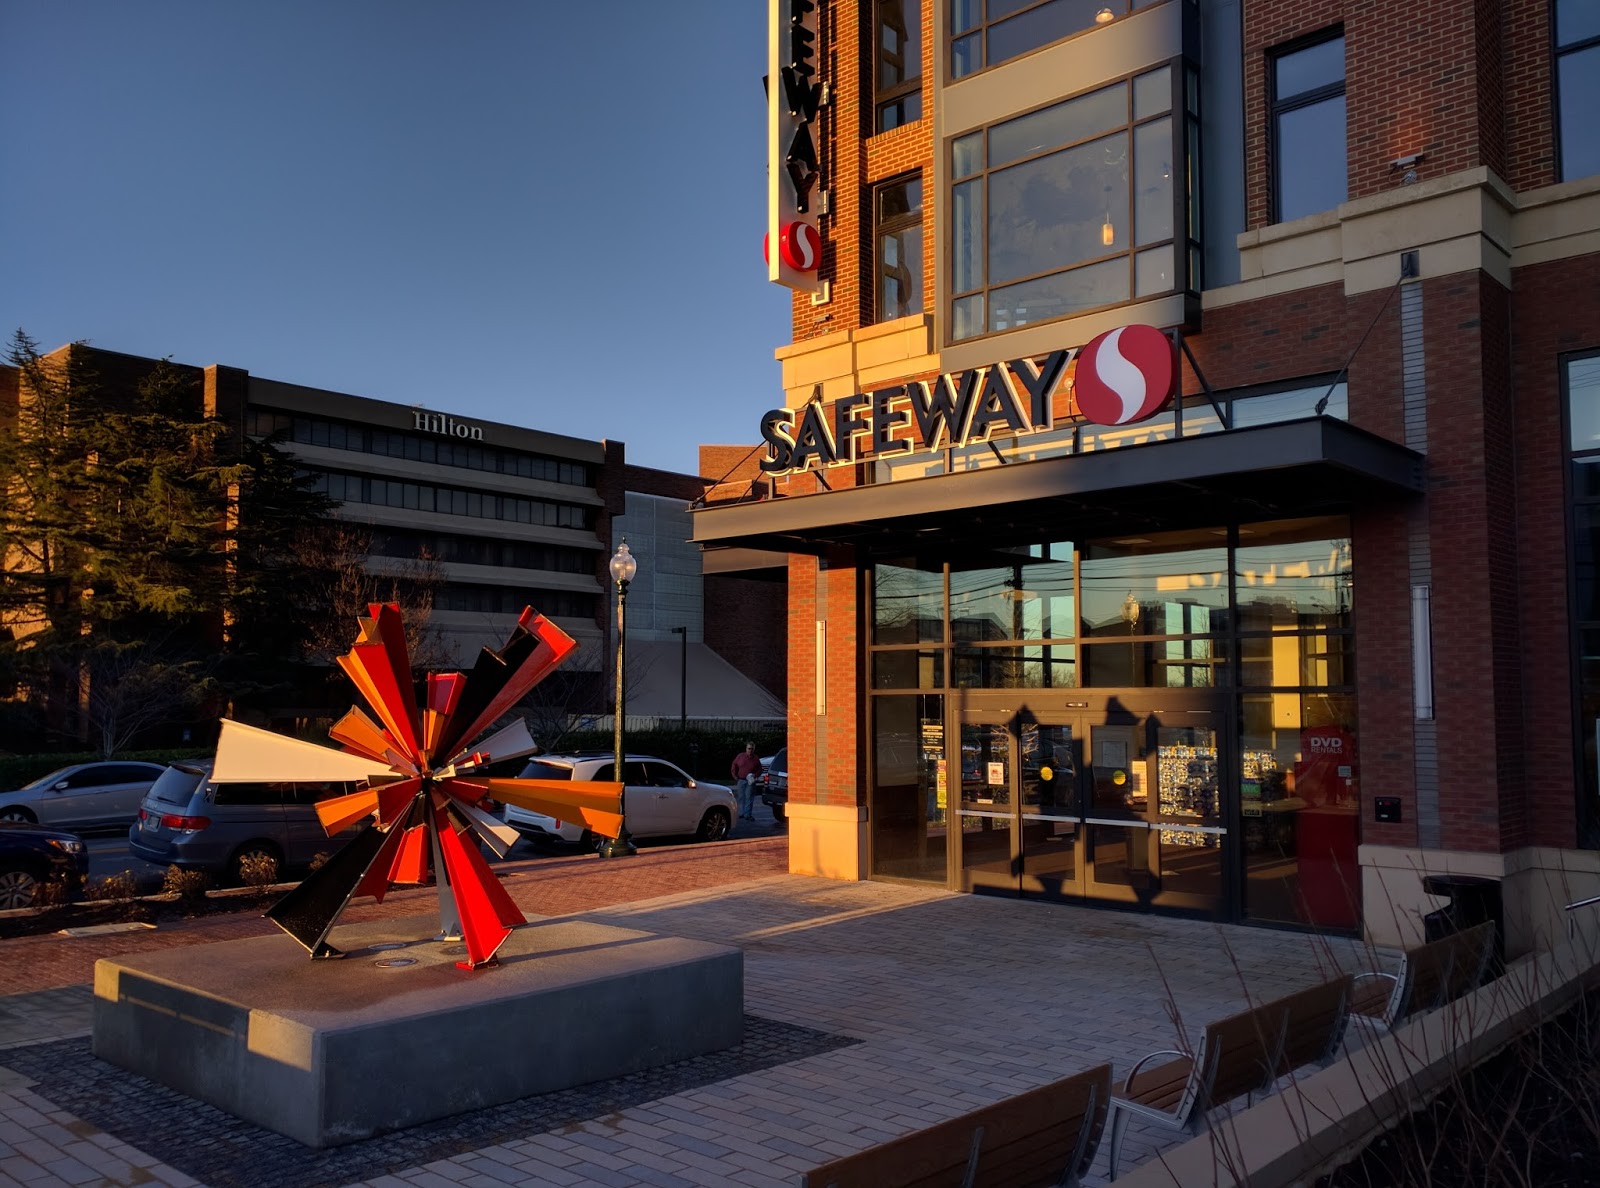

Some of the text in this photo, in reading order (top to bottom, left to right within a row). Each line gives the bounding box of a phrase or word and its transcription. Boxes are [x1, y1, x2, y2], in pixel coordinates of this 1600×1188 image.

[412, 411, 484, 441] Hilton
[759, 349, 1076, 475] SAFEWAY
[1310, 737, 1342, 747] DVD
